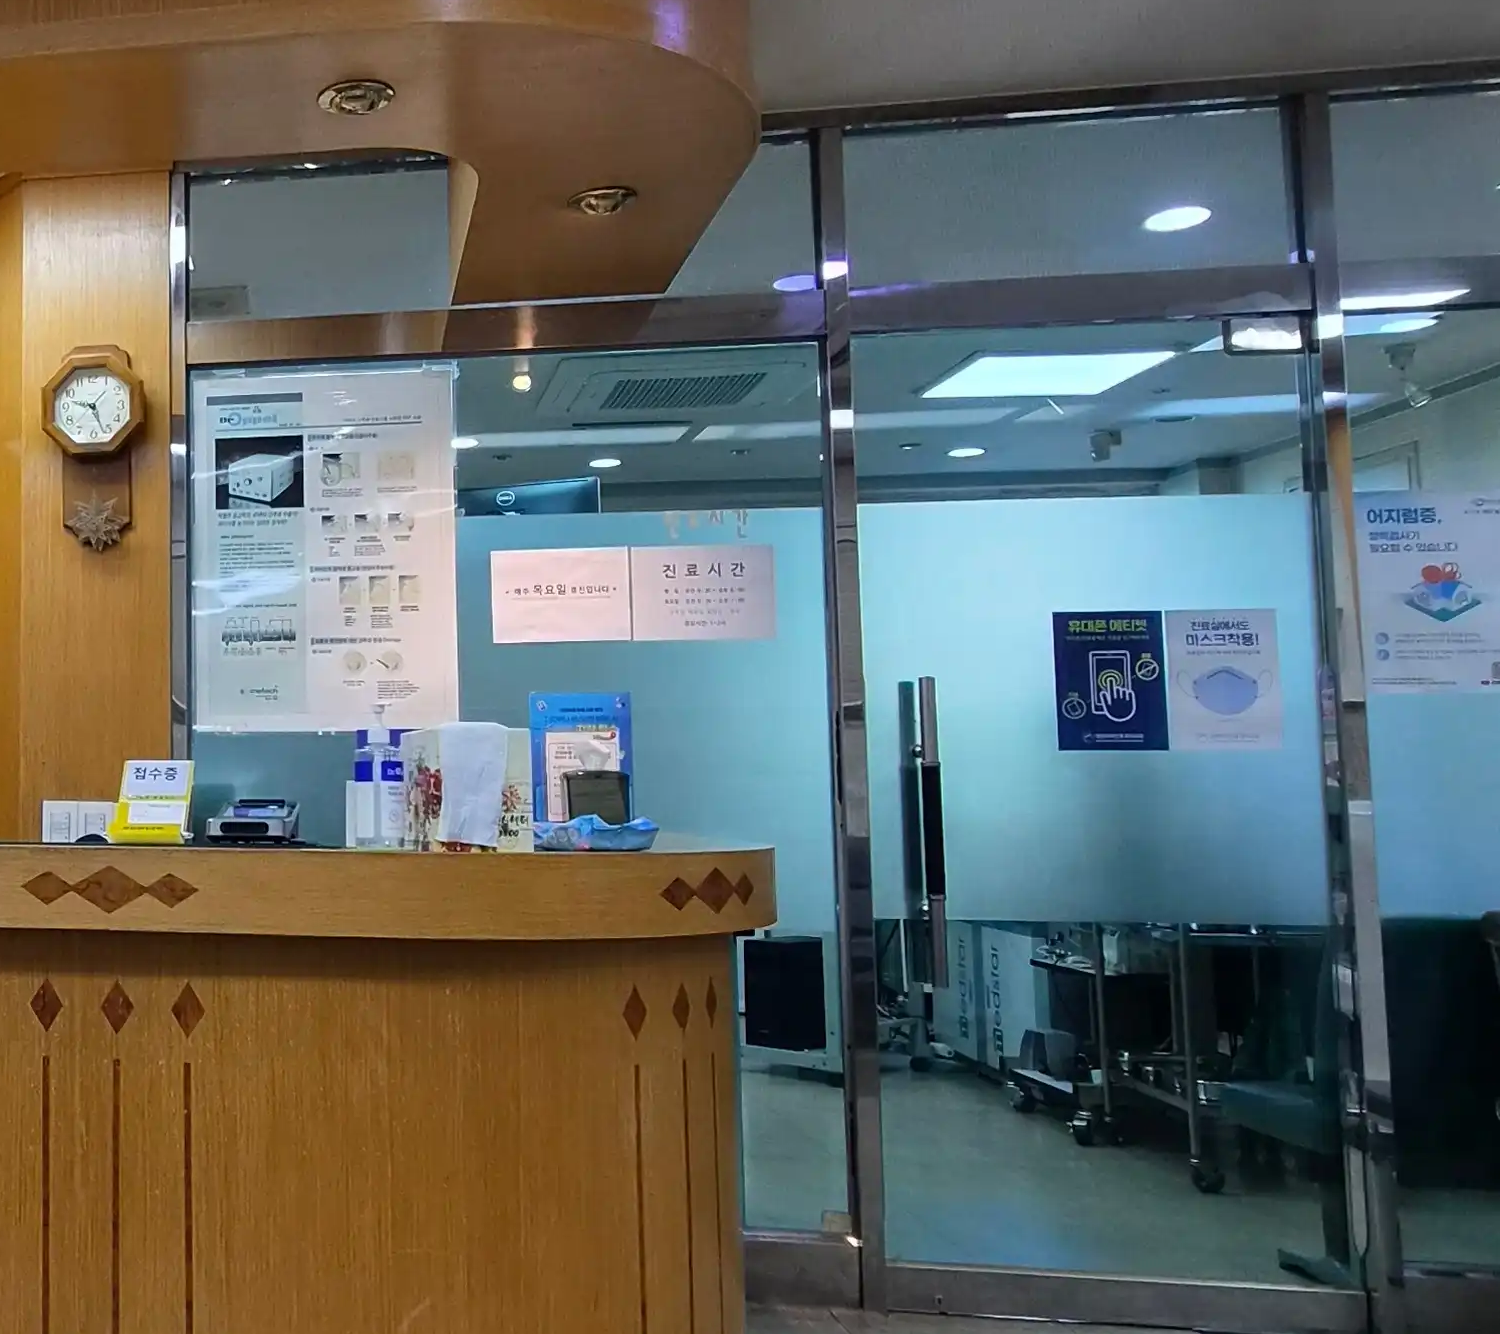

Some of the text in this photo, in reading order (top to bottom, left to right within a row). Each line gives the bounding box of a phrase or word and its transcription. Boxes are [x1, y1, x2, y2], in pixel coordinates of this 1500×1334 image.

[76, 377, 83, 387] 11
[88, 375, 98, 384] 12
[65, 388, 75, 399] 10
[113, 385, 121, 396] 2
[62, 402, 70, 413] 9
[116, 400, 125, 411] 3
[65, 415, 74, 426] 8
[113, 414, 121, 423] 4
[90, 429, 98, 440] 6
[104, 424, 112, 434] 5
[1366, 507, 1443, 525] 어지럼증,
[1403, 543, 1413, 553] 수
[1415, 542, 1459, 552] 있습니다
[662, 561, 746, 579] 진료시간
[533, 583, 566, 596] 목요일
[1068, 618, 1147, 633] 휴대폰 에티켓
[132, 766, 179, 782] 접수증
